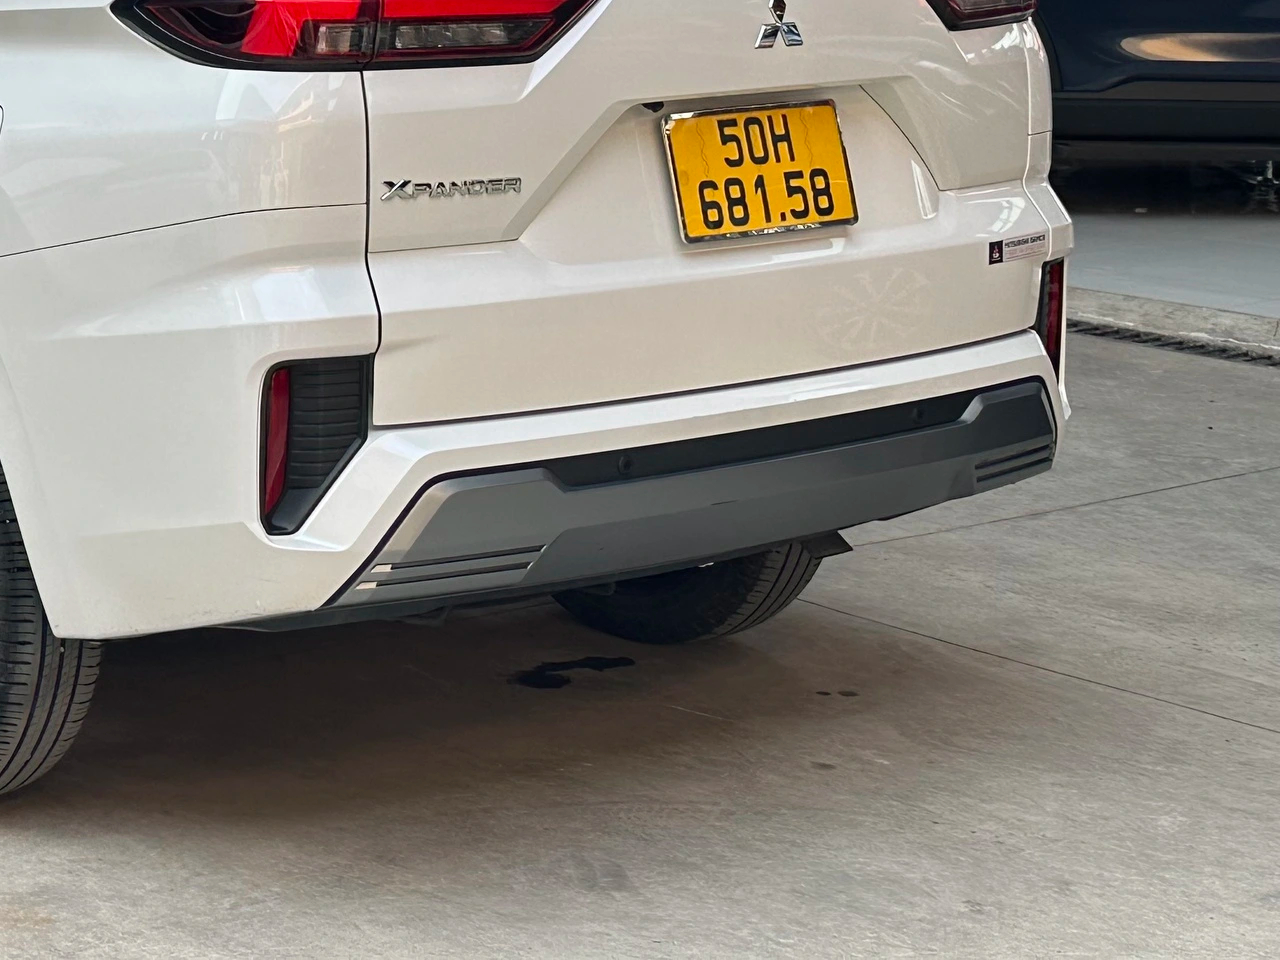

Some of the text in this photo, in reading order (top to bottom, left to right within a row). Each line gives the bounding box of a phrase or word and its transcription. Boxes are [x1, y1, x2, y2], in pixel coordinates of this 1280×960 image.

[717, 114, 796, 168] 50H
[380, 177, 523, 202] XPANDER
[698, 168, 835, 230] 681.58
